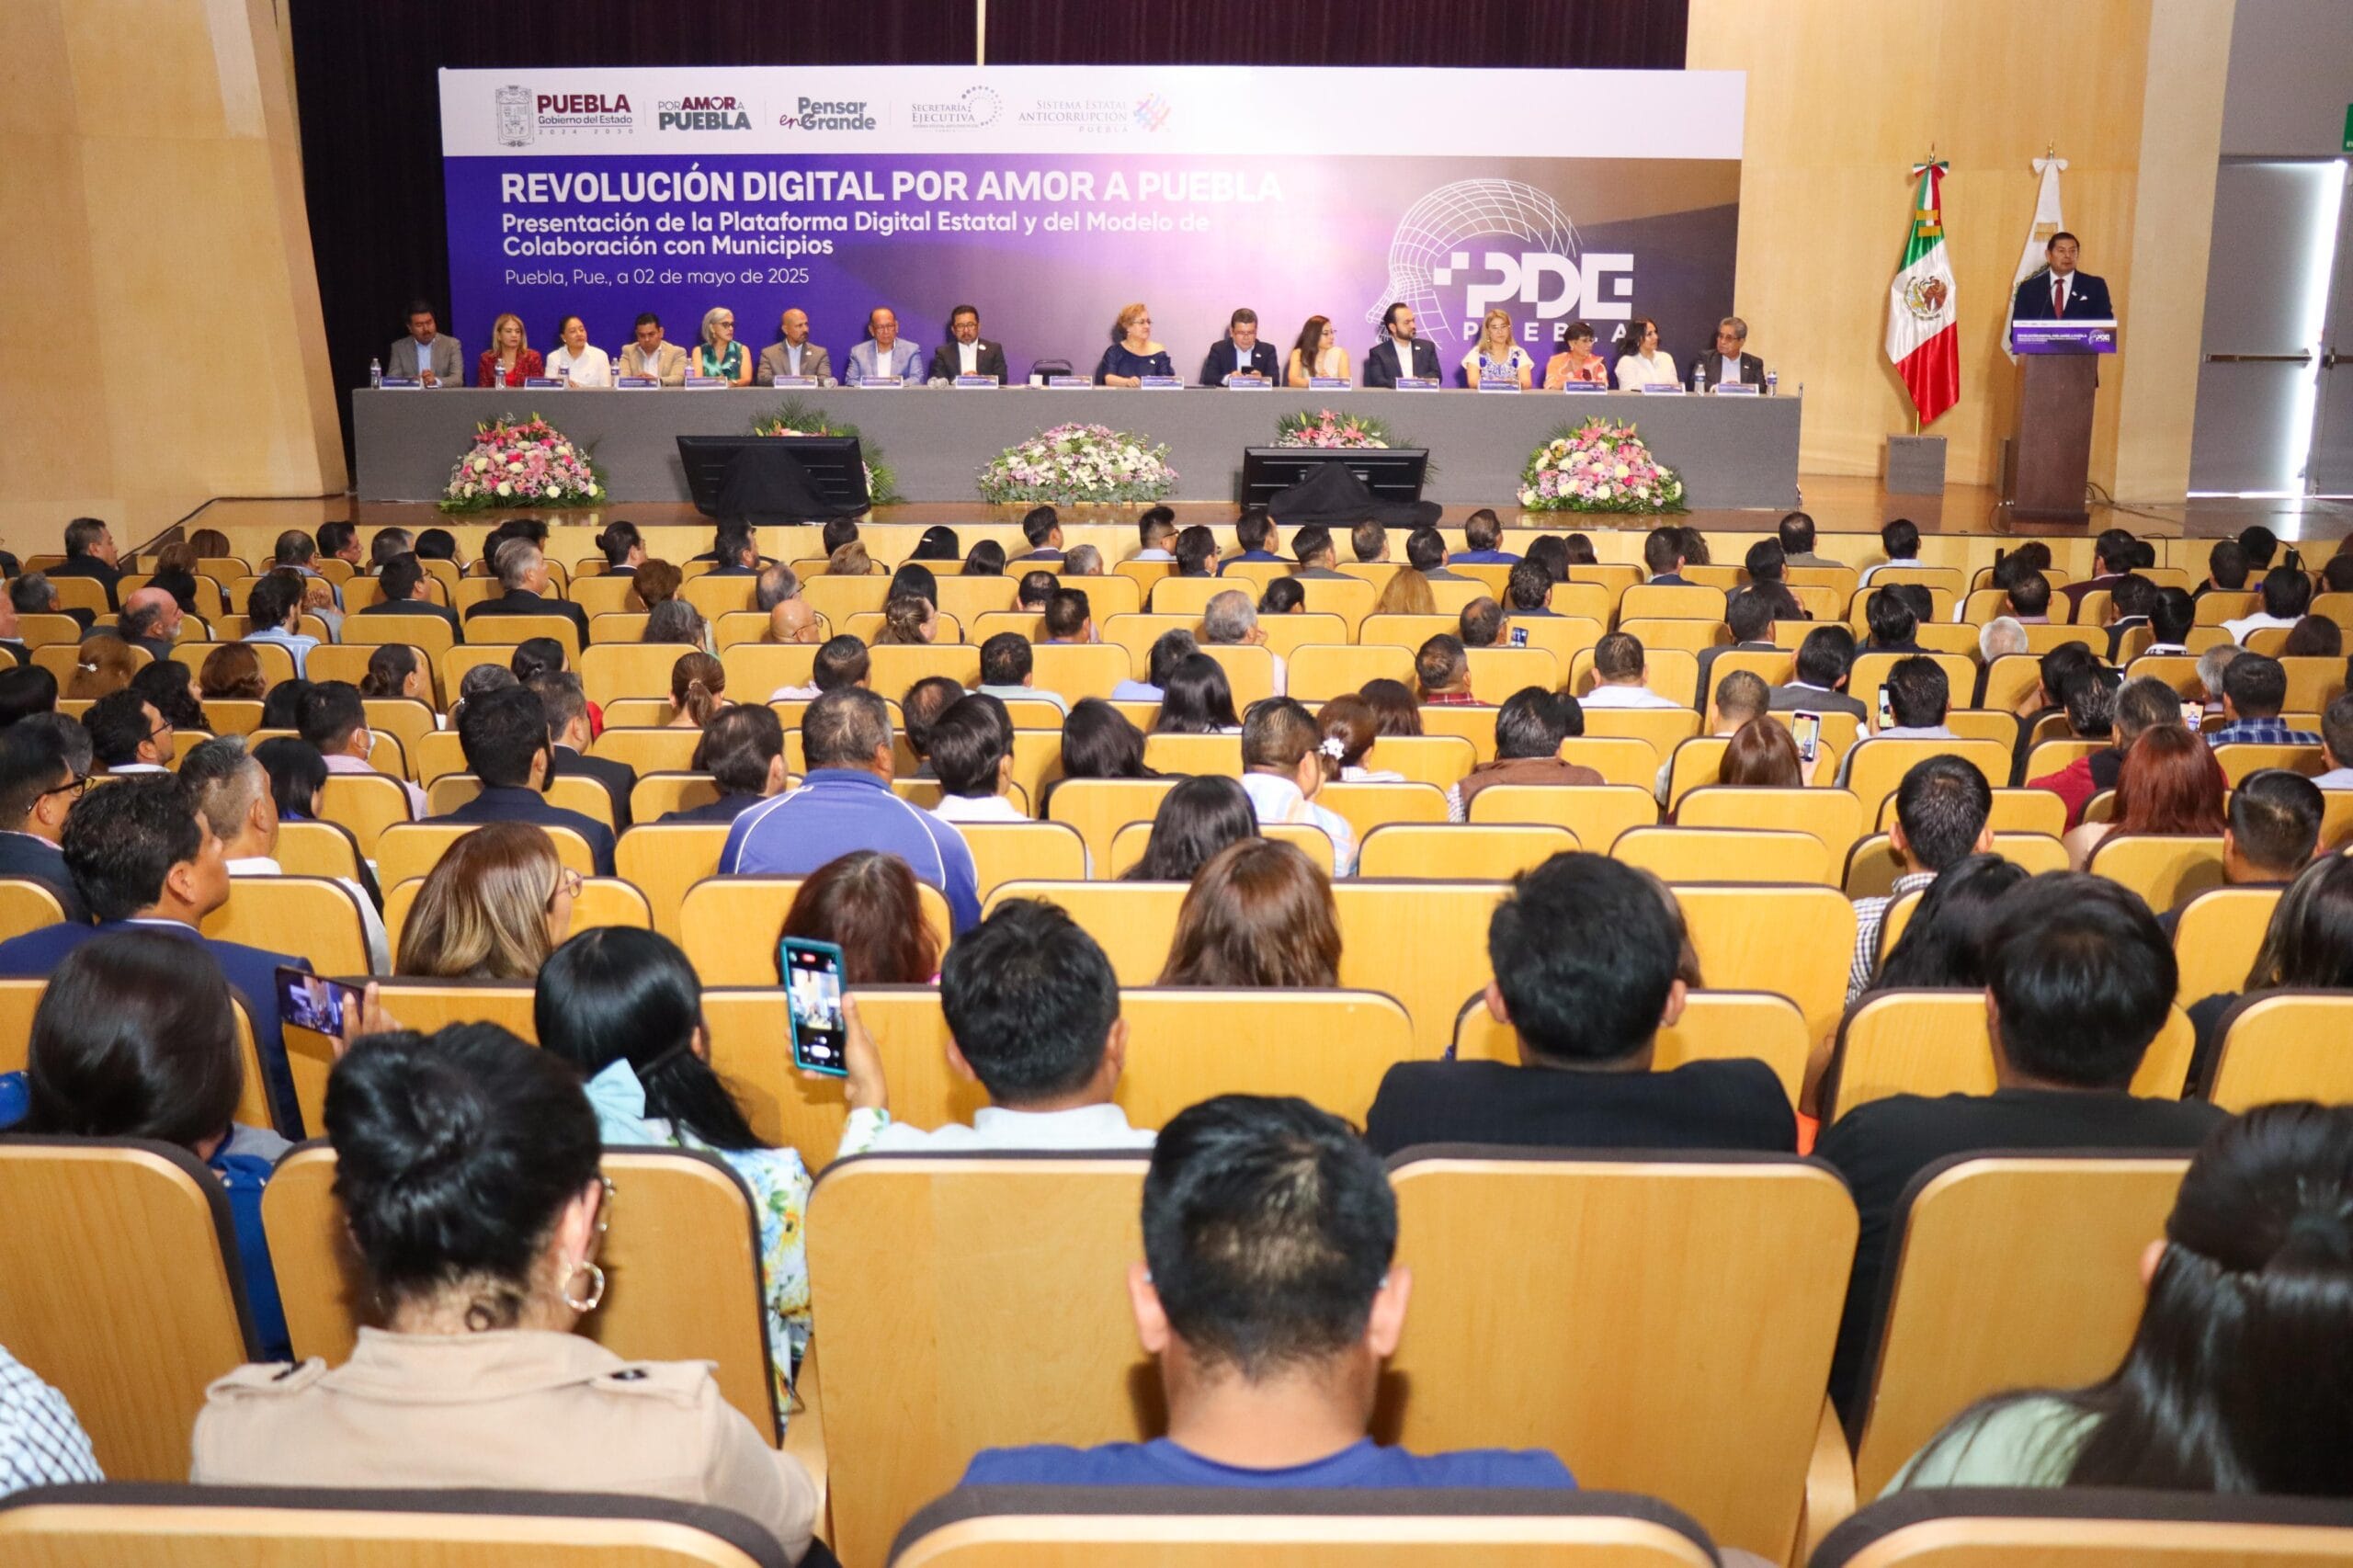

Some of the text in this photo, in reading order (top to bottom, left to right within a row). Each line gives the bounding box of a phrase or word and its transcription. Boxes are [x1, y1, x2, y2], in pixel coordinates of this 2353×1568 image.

[537, 94, 632, 114] PUEBLA
[658, 97, 745, 111] POR AMOR A
[798, 97, 867, 114] Pensar
[1037, 100, 1082, 110] SISTEMA
[538, 115, 632, 124] Gobierno del Estado
[659, 111, 752, 131] PUEBLA
[801, 112, 877, 131] Grande
[912, 112, 976, 123] EJECUTIVA
[501, 162, 1284, 203] REVOLUCIÓN DIGITAL POR AMOR A PUEBLA
[503, 210, 1211, 236] Presentación de la Plataforma Digital Estatal y del Modelo de
[503, 234, 835, 260] Colaboración con Municipios
[506, 268, 810, 287] Puebla, Pue., a 02 de mayo de 2025
[1466, 252, 1634, 320] PDE
